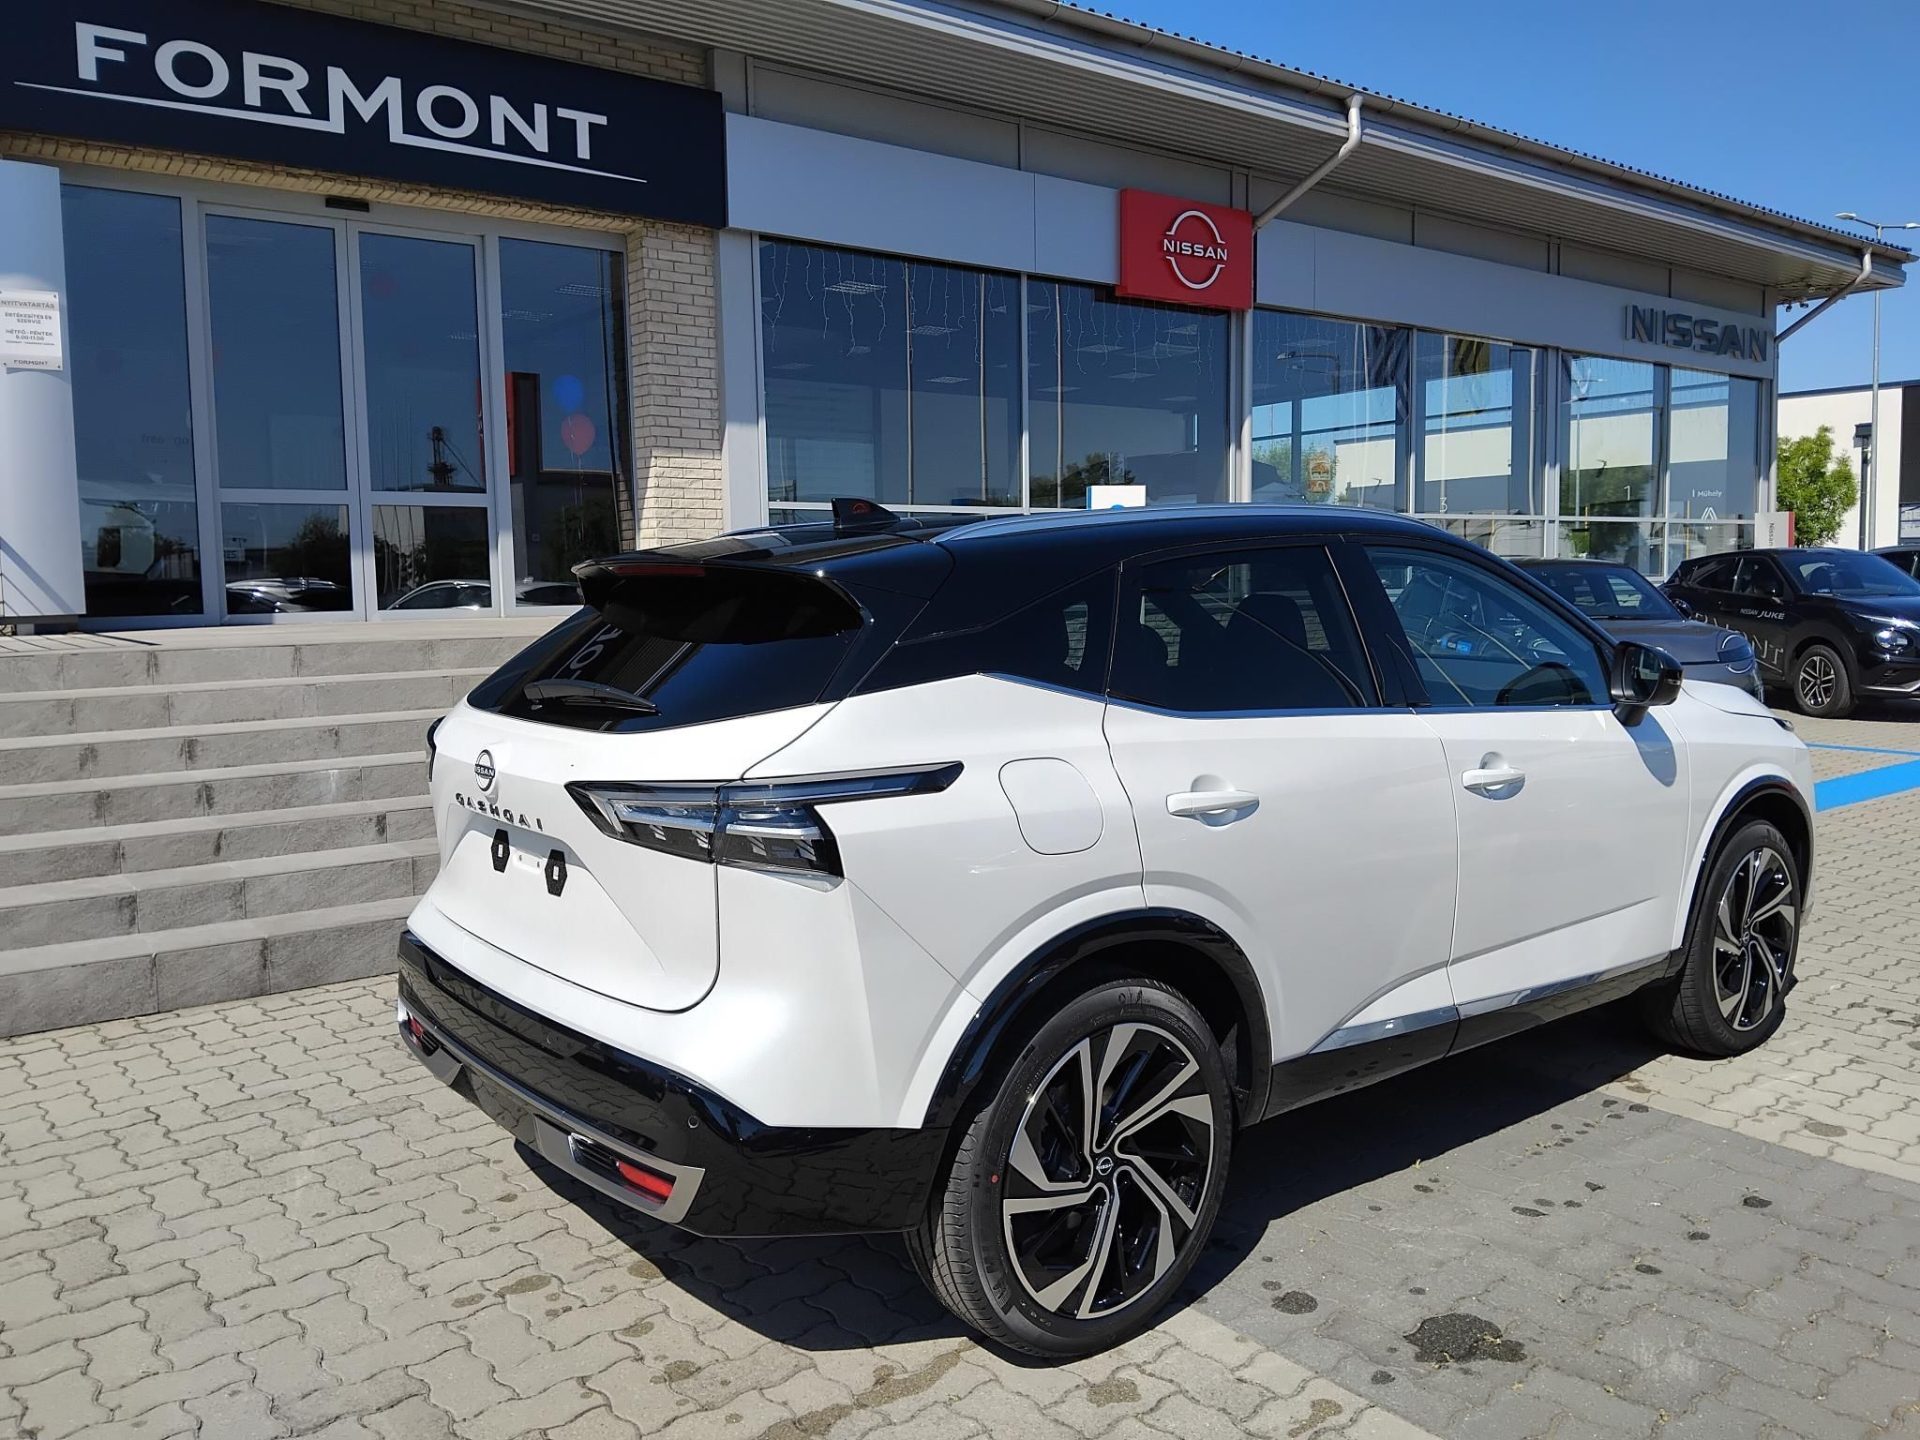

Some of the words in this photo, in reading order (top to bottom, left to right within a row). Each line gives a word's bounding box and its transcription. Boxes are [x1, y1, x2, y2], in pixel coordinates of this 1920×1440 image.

[75, 21, 608, 160] FORMONT
[1163, 239, 1228, 261] NISSAN
[1625, 304, 1768, 362] NISSAN
[1757, 610, 1785, 620] JUKE
[455, 792, 544, 832] QASHQAI
